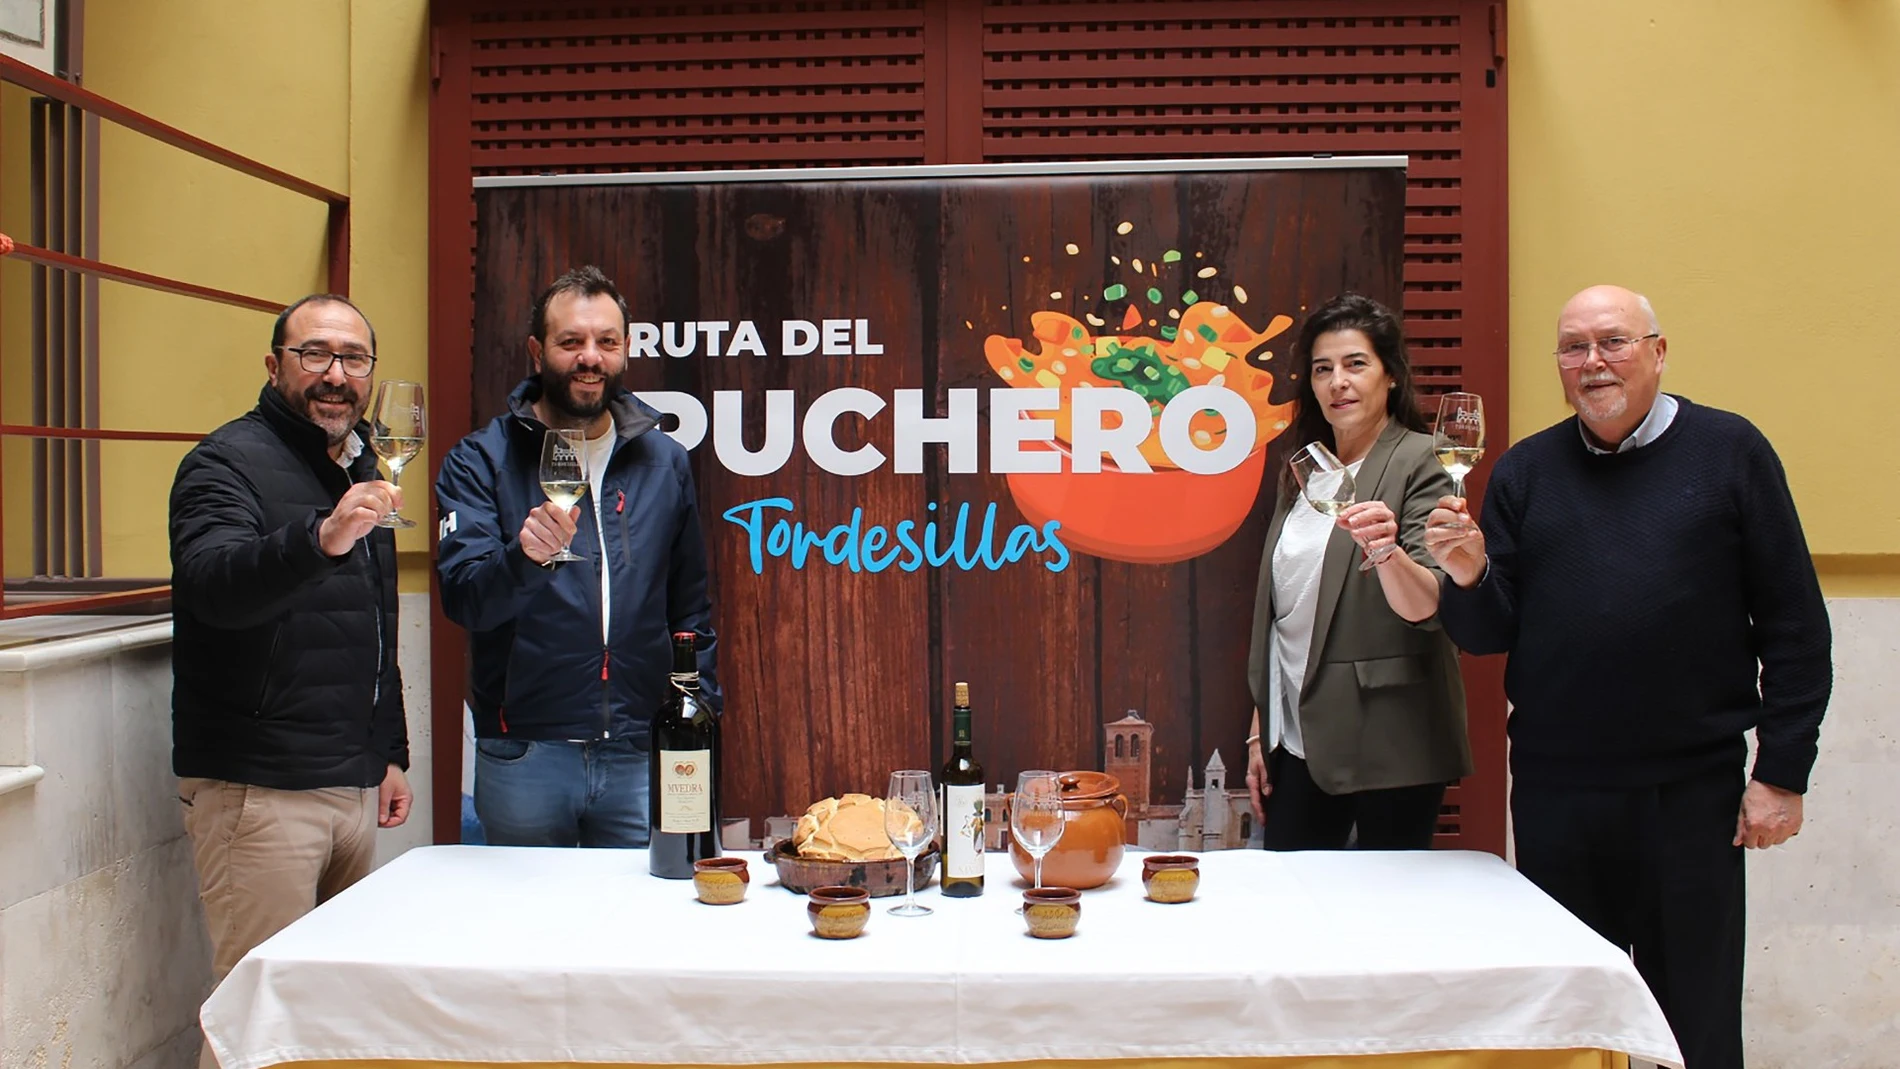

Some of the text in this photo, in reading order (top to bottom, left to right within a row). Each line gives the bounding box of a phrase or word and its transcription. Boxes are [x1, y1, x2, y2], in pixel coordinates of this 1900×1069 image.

[628, 319, 884, 358] RUTA DEL
[632, 386, 1257, 476] PUCHERO
[723, 497, 1070, 574] Tordesillas
[667, 783, 703, 793] MVEDRA
